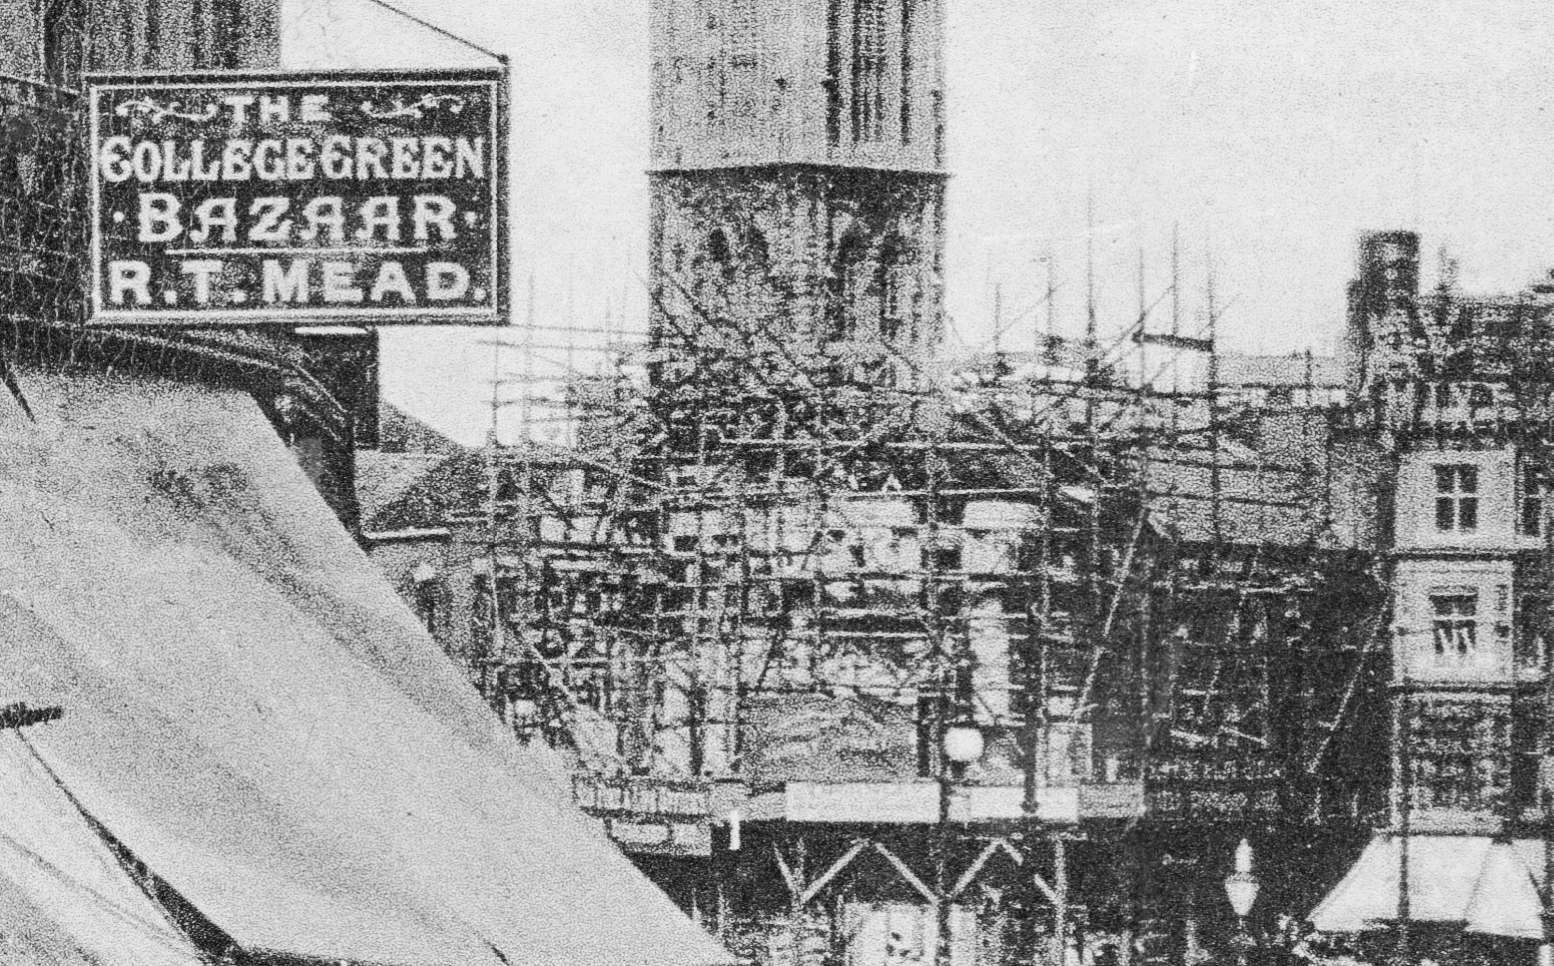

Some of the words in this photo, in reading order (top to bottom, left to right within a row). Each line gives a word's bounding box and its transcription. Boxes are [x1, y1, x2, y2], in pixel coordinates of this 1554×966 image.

[229, 94, 332, 122] THE
[100, 134, 315, 182] COLLEGE
[319, 133, 484, 180] GREEN
[108, 259, 246, 304] R.T.
